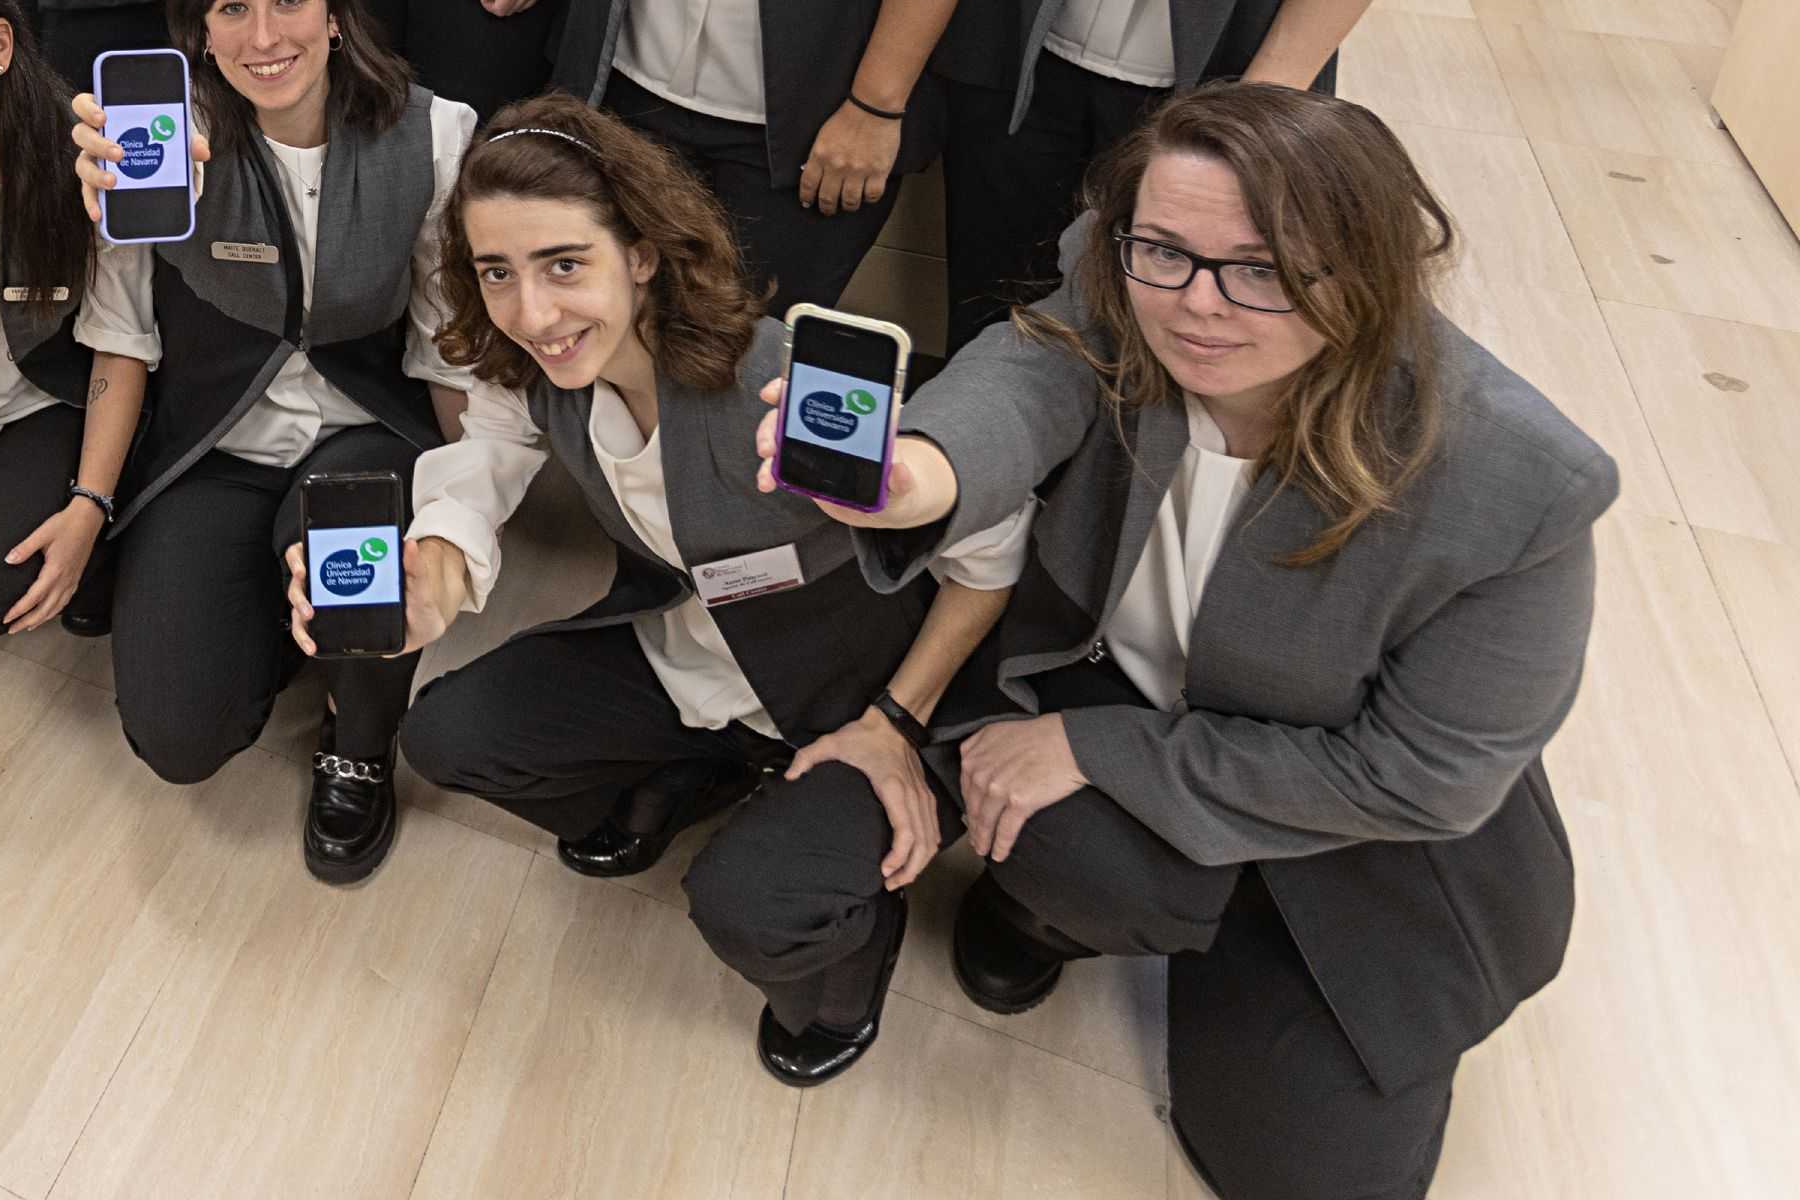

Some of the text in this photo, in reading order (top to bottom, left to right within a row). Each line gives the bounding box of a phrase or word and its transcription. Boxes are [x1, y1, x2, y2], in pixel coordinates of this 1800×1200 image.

[131, 158, 158, 166] Navarra
[327, 568, 370, 577] Universidad
[338, 577, 368, 585] Navarra
